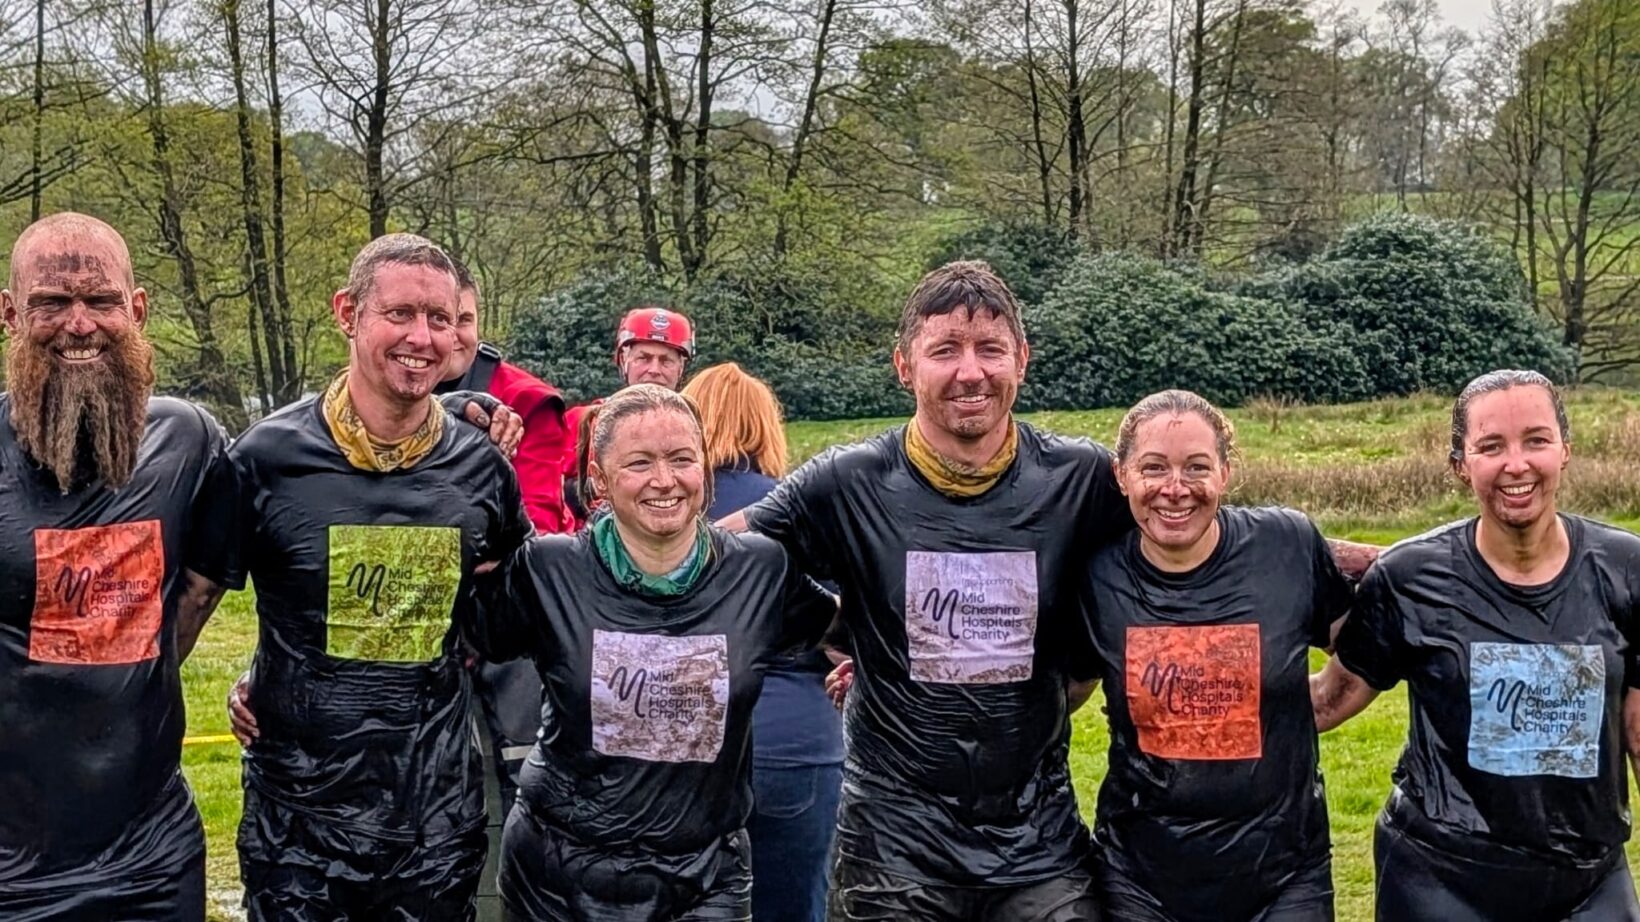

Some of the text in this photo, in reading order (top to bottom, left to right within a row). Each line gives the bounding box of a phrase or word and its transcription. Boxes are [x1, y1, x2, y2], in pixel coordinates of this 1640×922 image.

[389, 568, 412, 579] Mid
[92, 579, 149, 592] Cheshire
[90, 591, 150, 606] Hospitals
[962, 592, 985, 603] Mid
[961, 604, 1020, 615] Cheshire
[962, 616, 1022, 629] Hospitals
[962, 629, 1010, 641] Charity
[650, 670, 674, 682] Mid
[1181, 665, 1204, 677] Mid
[649, 683, 711, 696] Cheshire
[1181, 678, 1242, 690] Cheshire
[1527, 684, 1551, 696] Mid
[649, 696, 715, 709] Hospitals
[1182, 690, 1243, 705] Hospitals
[1525, 696, 1586, 709] Cheshire
[648, 708, 697, 723] Charity
[1182, 704, 1230, 720] Charity
[1524, 709, 1587, 721] Hospitals
[1523, 721, 1571, 735] Charity
